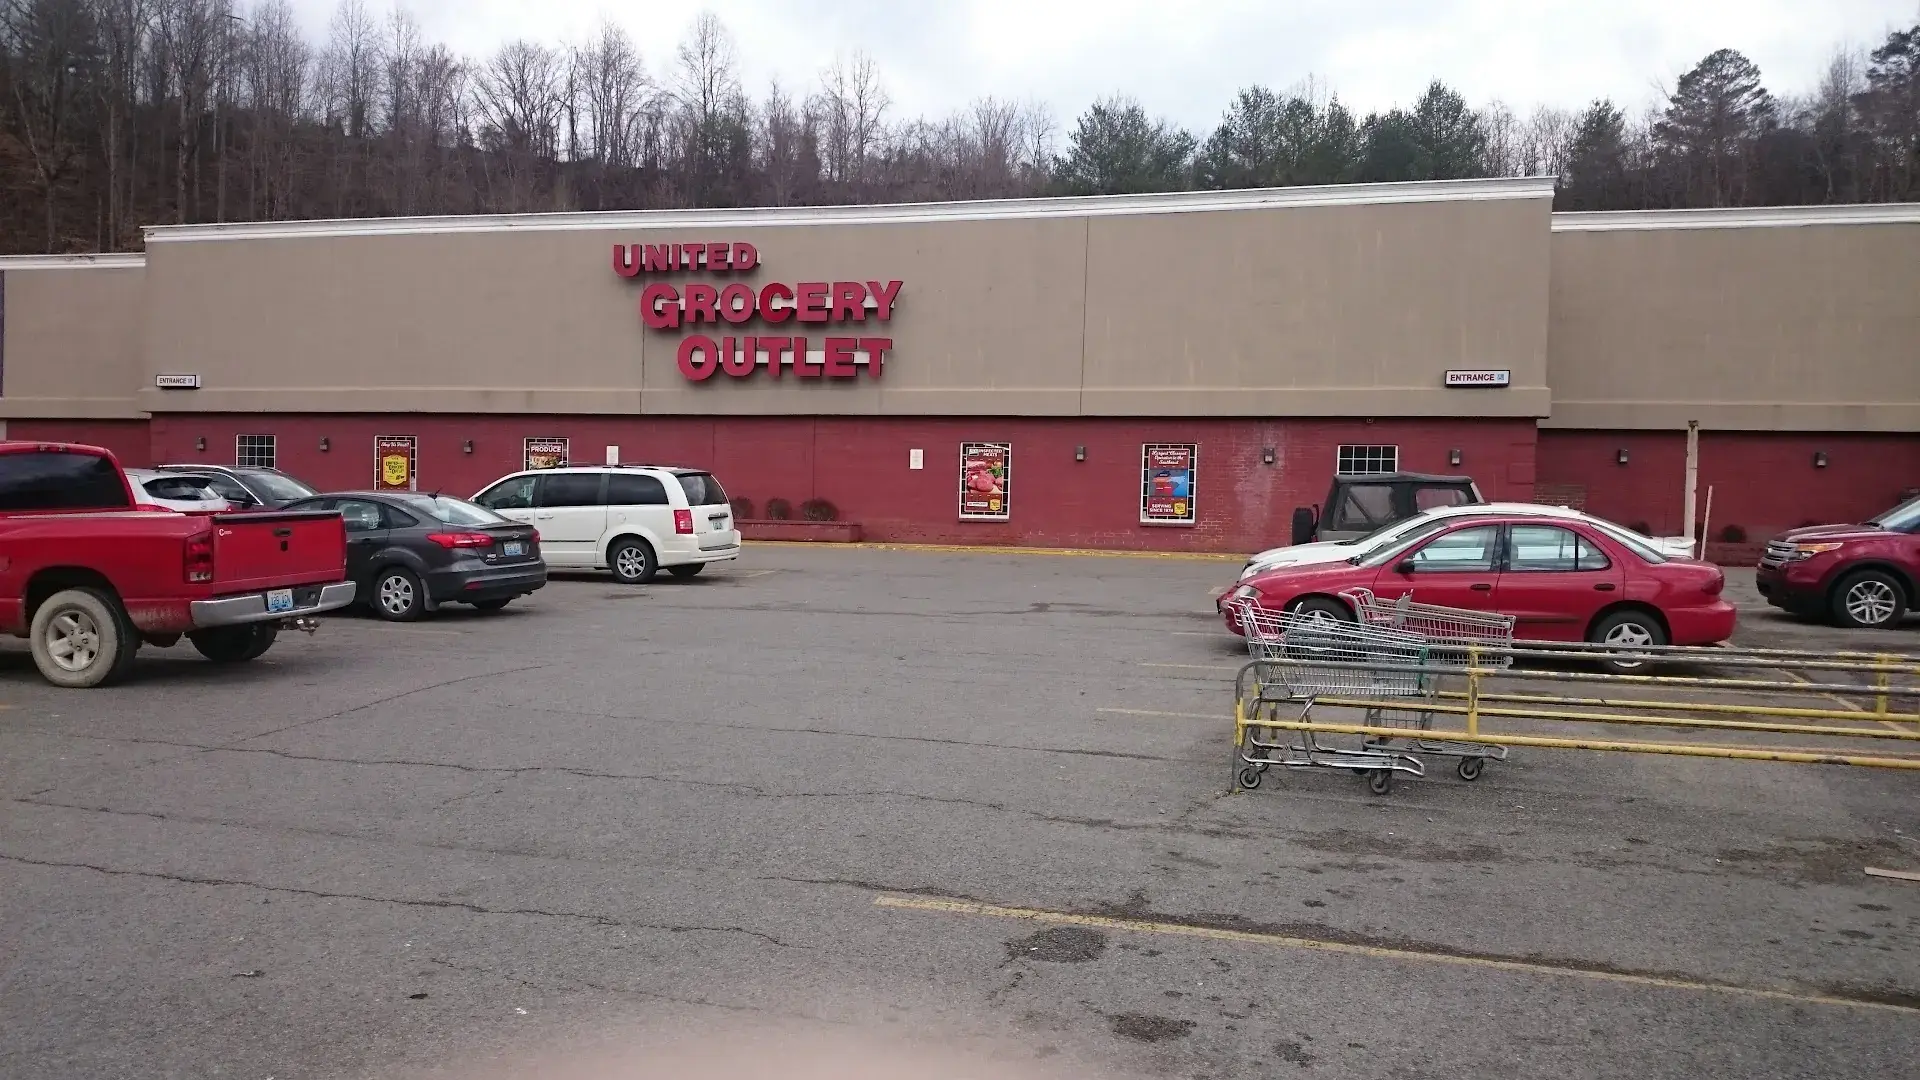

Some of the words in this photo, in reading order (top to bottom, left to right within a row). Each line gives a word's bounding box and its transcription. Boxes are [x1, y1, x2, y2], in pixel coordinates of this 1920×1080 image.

[613, 242, 759, 277] UNITED
[640, 281, 903, 328] GROCERY
[677, 335, 892, 381] OUTLET
[1450, 374, 1495, 382] ENTRANCE
